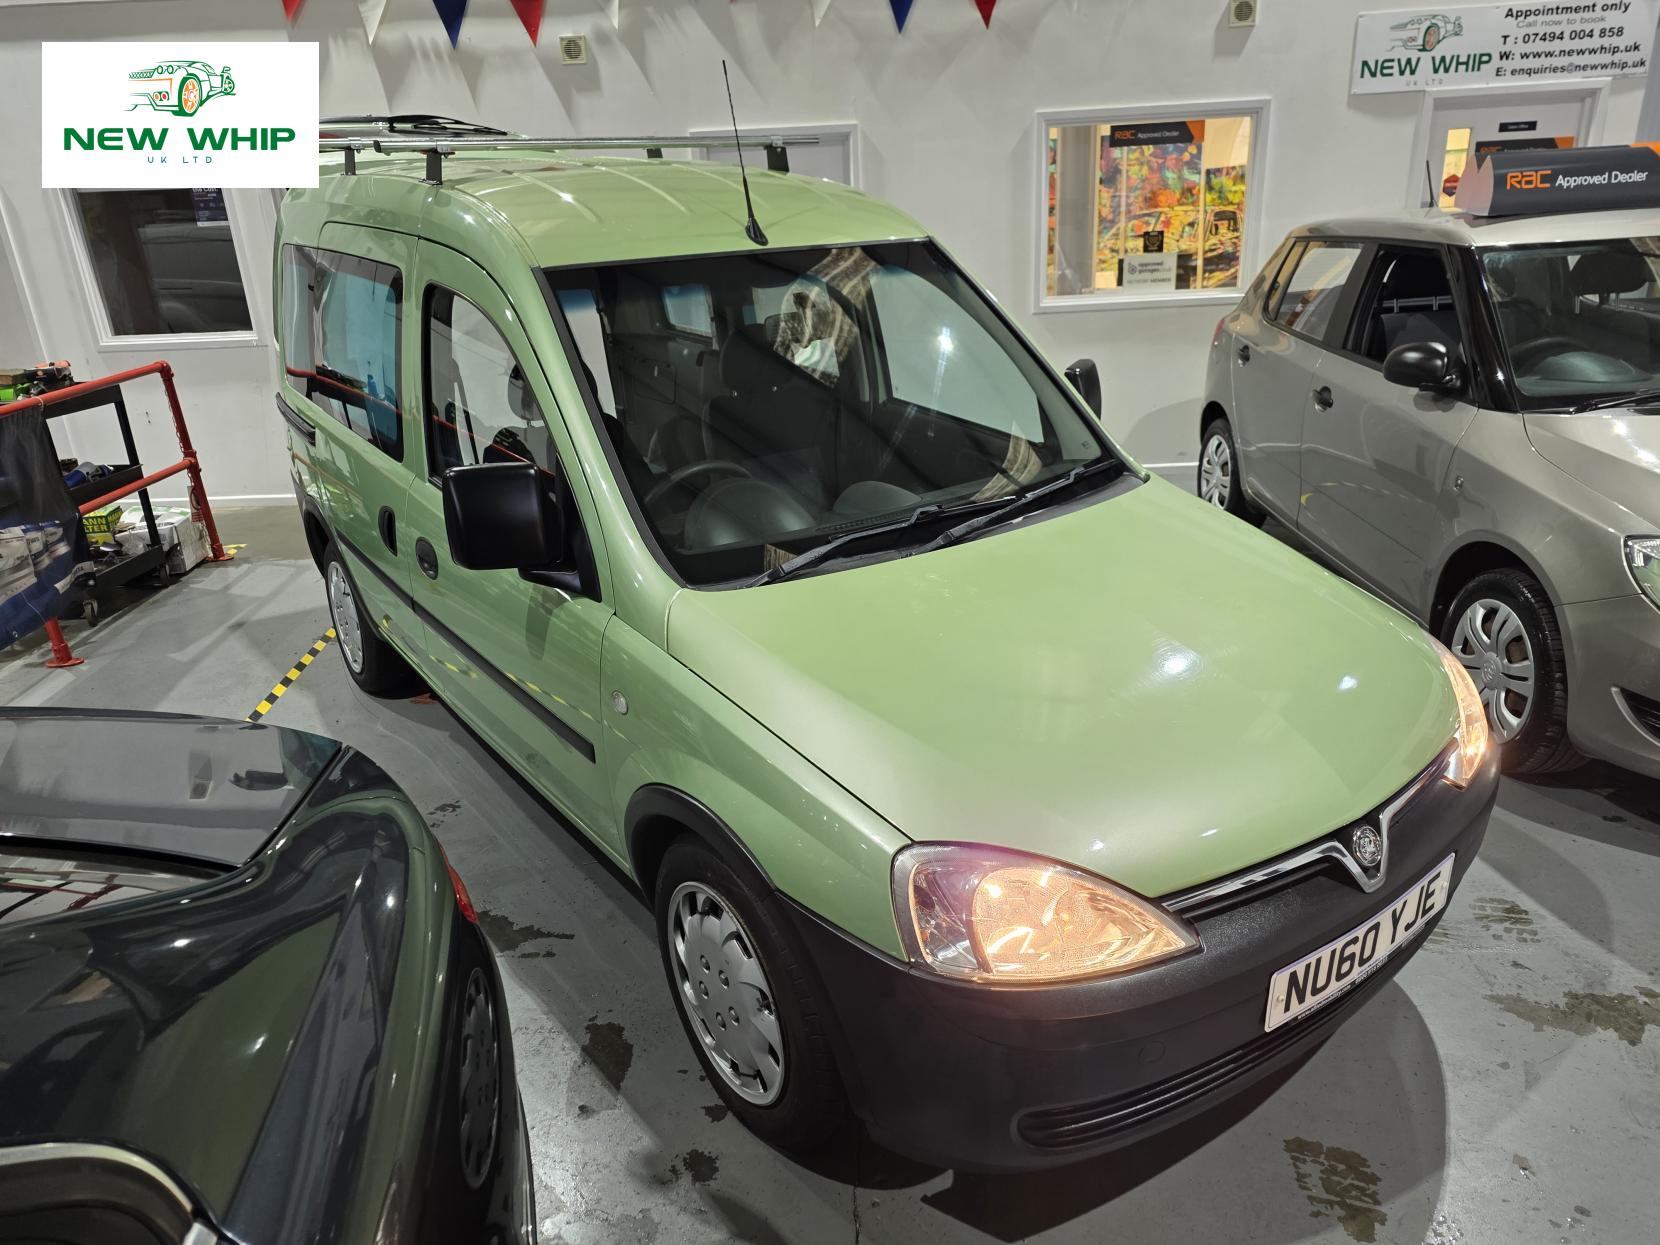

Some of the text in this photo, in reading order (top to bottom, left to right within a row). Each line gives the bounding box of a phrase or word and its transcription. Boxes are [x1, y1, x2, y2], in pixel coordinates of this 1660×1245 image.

[1504, 0, 1631, 20] Appointment only
[1516, 15, 1607, 29] Call now to book
[1501, 34, 1510, 45] T
[1522, 31, 1564, 44] 07494
[1569, 28, 1594, 41] 004
[1598, 26, 1624, 38] 858
[1499, 42, 1642, 61] W: www.newwhip.uk
[1360, 52, 1493, 79] NEW WHIP
[1495, 58, 1648, 77] E: enquiries@newwhip.uk
[1555, 172, 1609, 189] Approved
[1611, 170, 1649, 184] Dealer
[1283, 921, 1381, 1014] NU60
[1390, 870, 1442, 945] YJE
